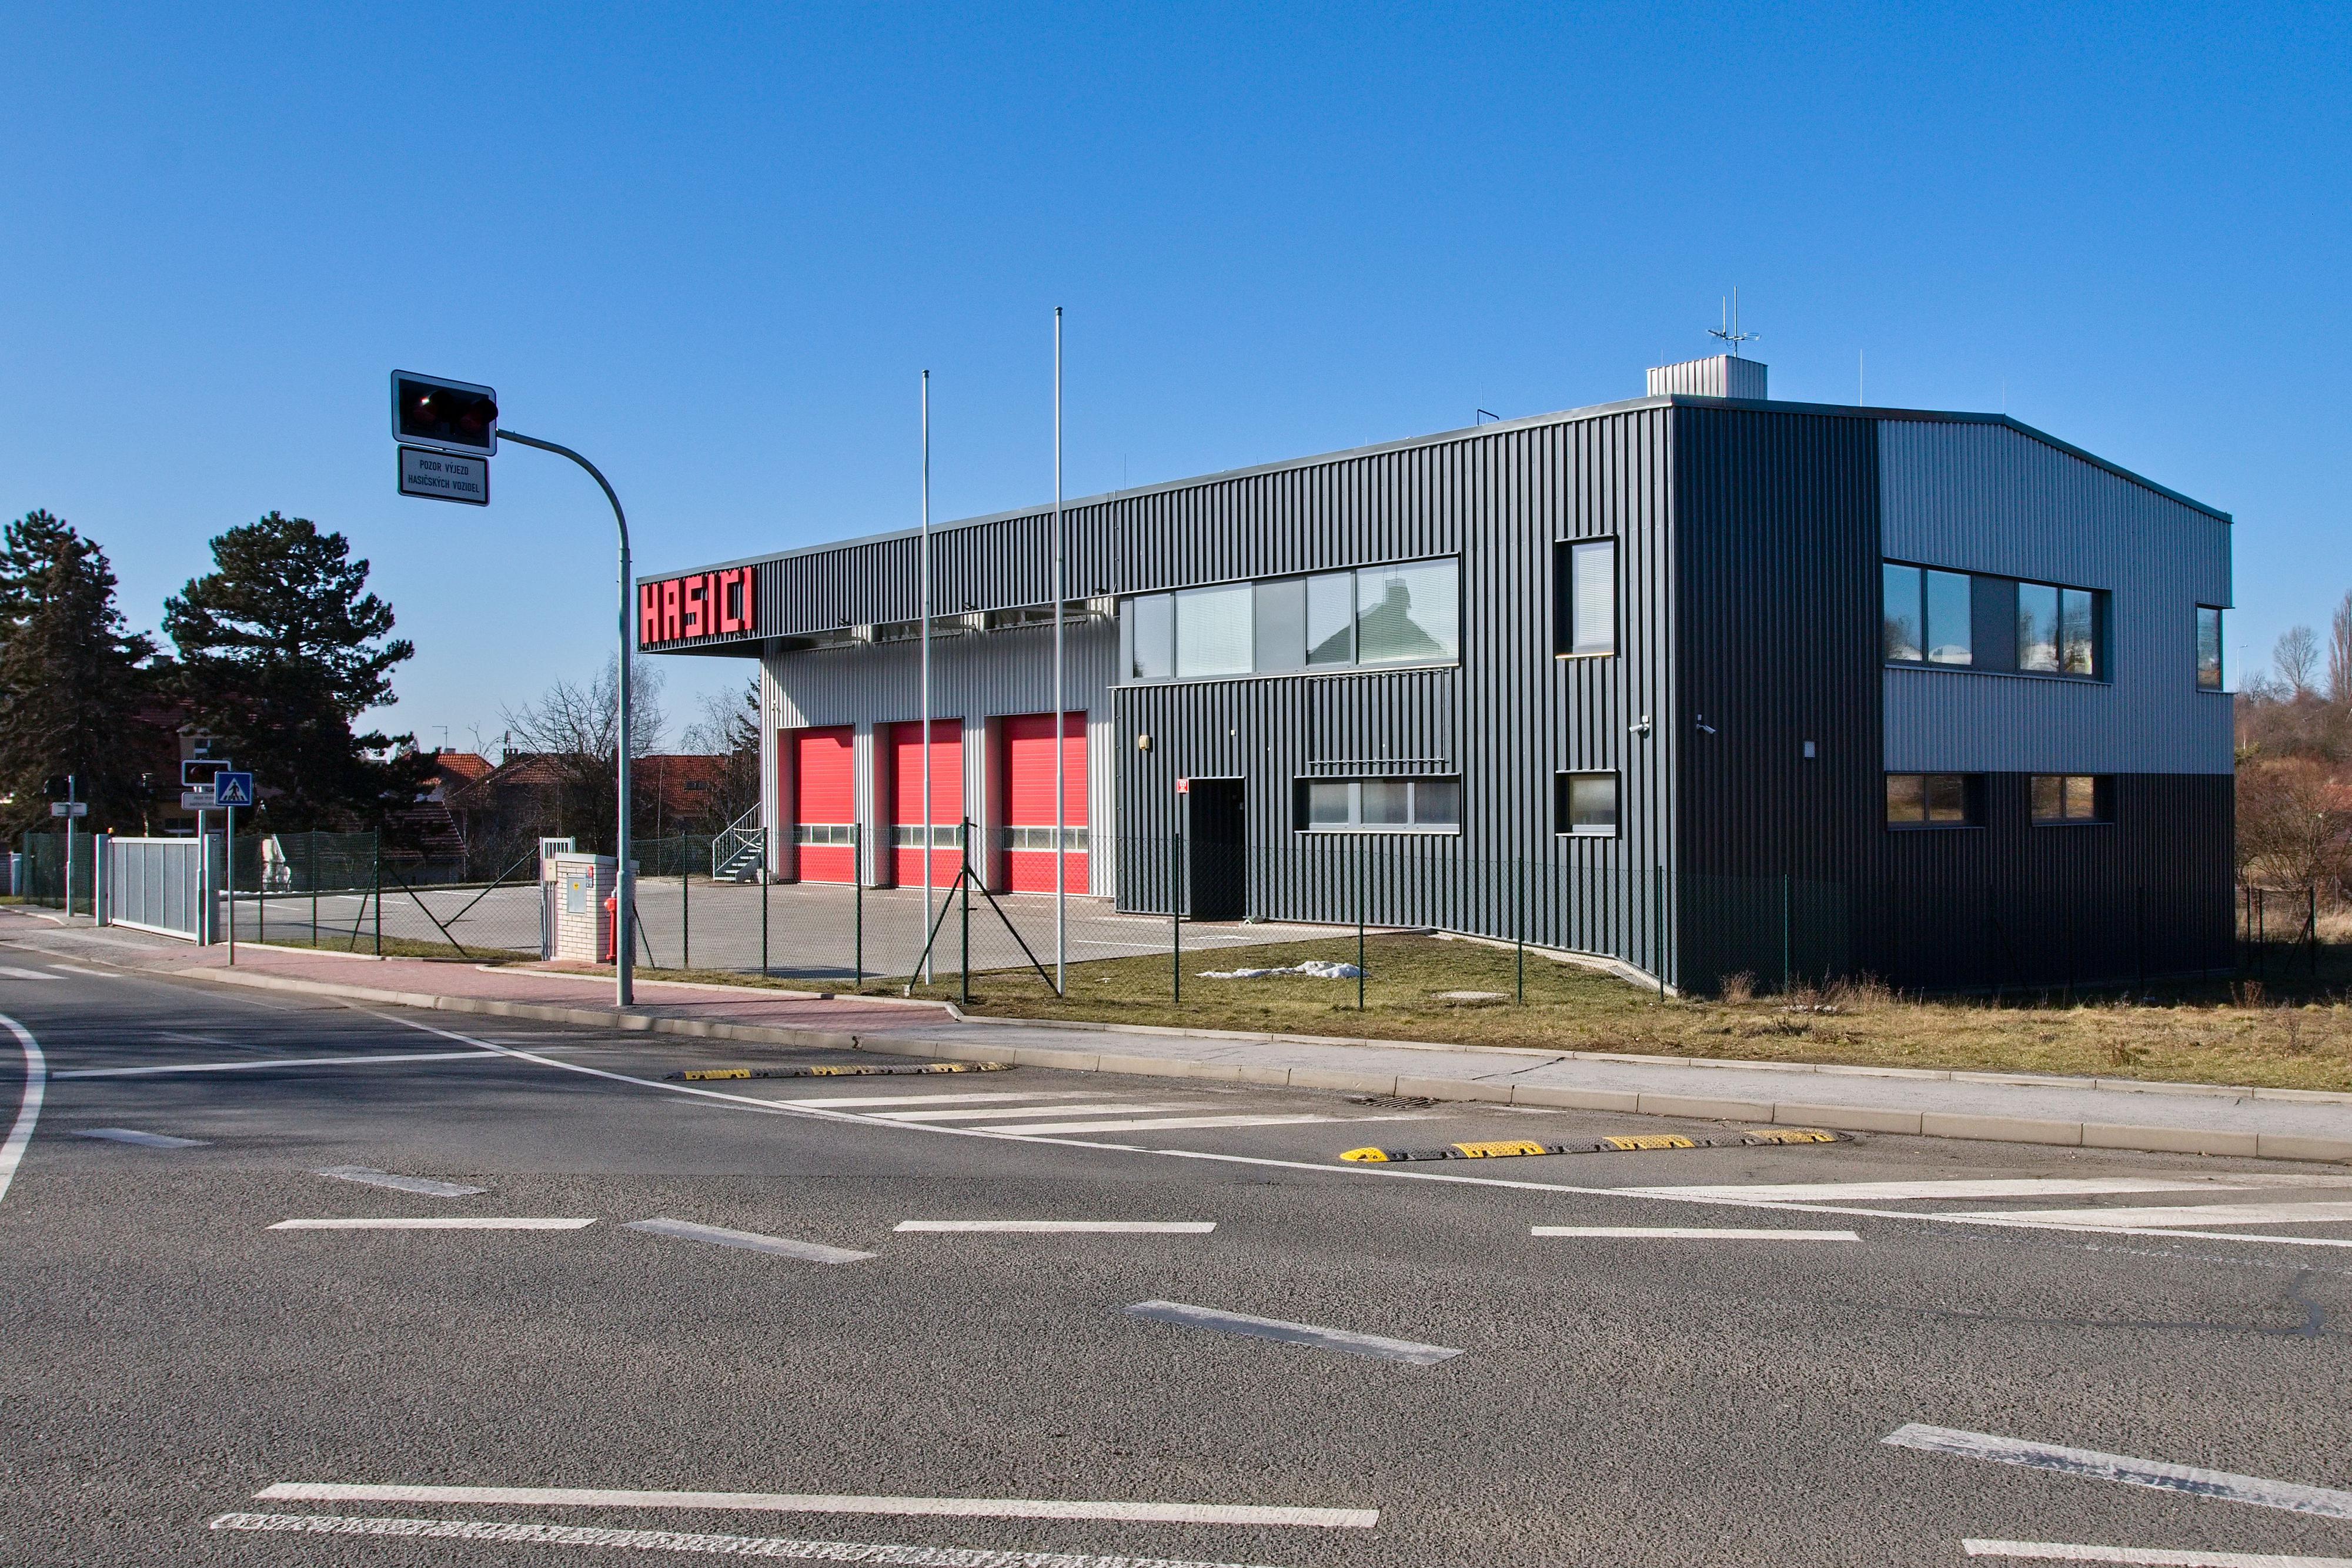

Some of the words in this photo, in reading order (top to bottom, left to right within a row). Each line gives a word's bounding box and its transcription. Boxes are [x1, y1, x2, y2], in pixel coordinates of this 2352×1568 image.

[420, 460, 442, 472] POZOR
[445, 462, 469, 475] VÝJEZD
[408, 474, 450, 489] HASIČSKÝCH
[452, 481, 480, 493] VOZIDEL
